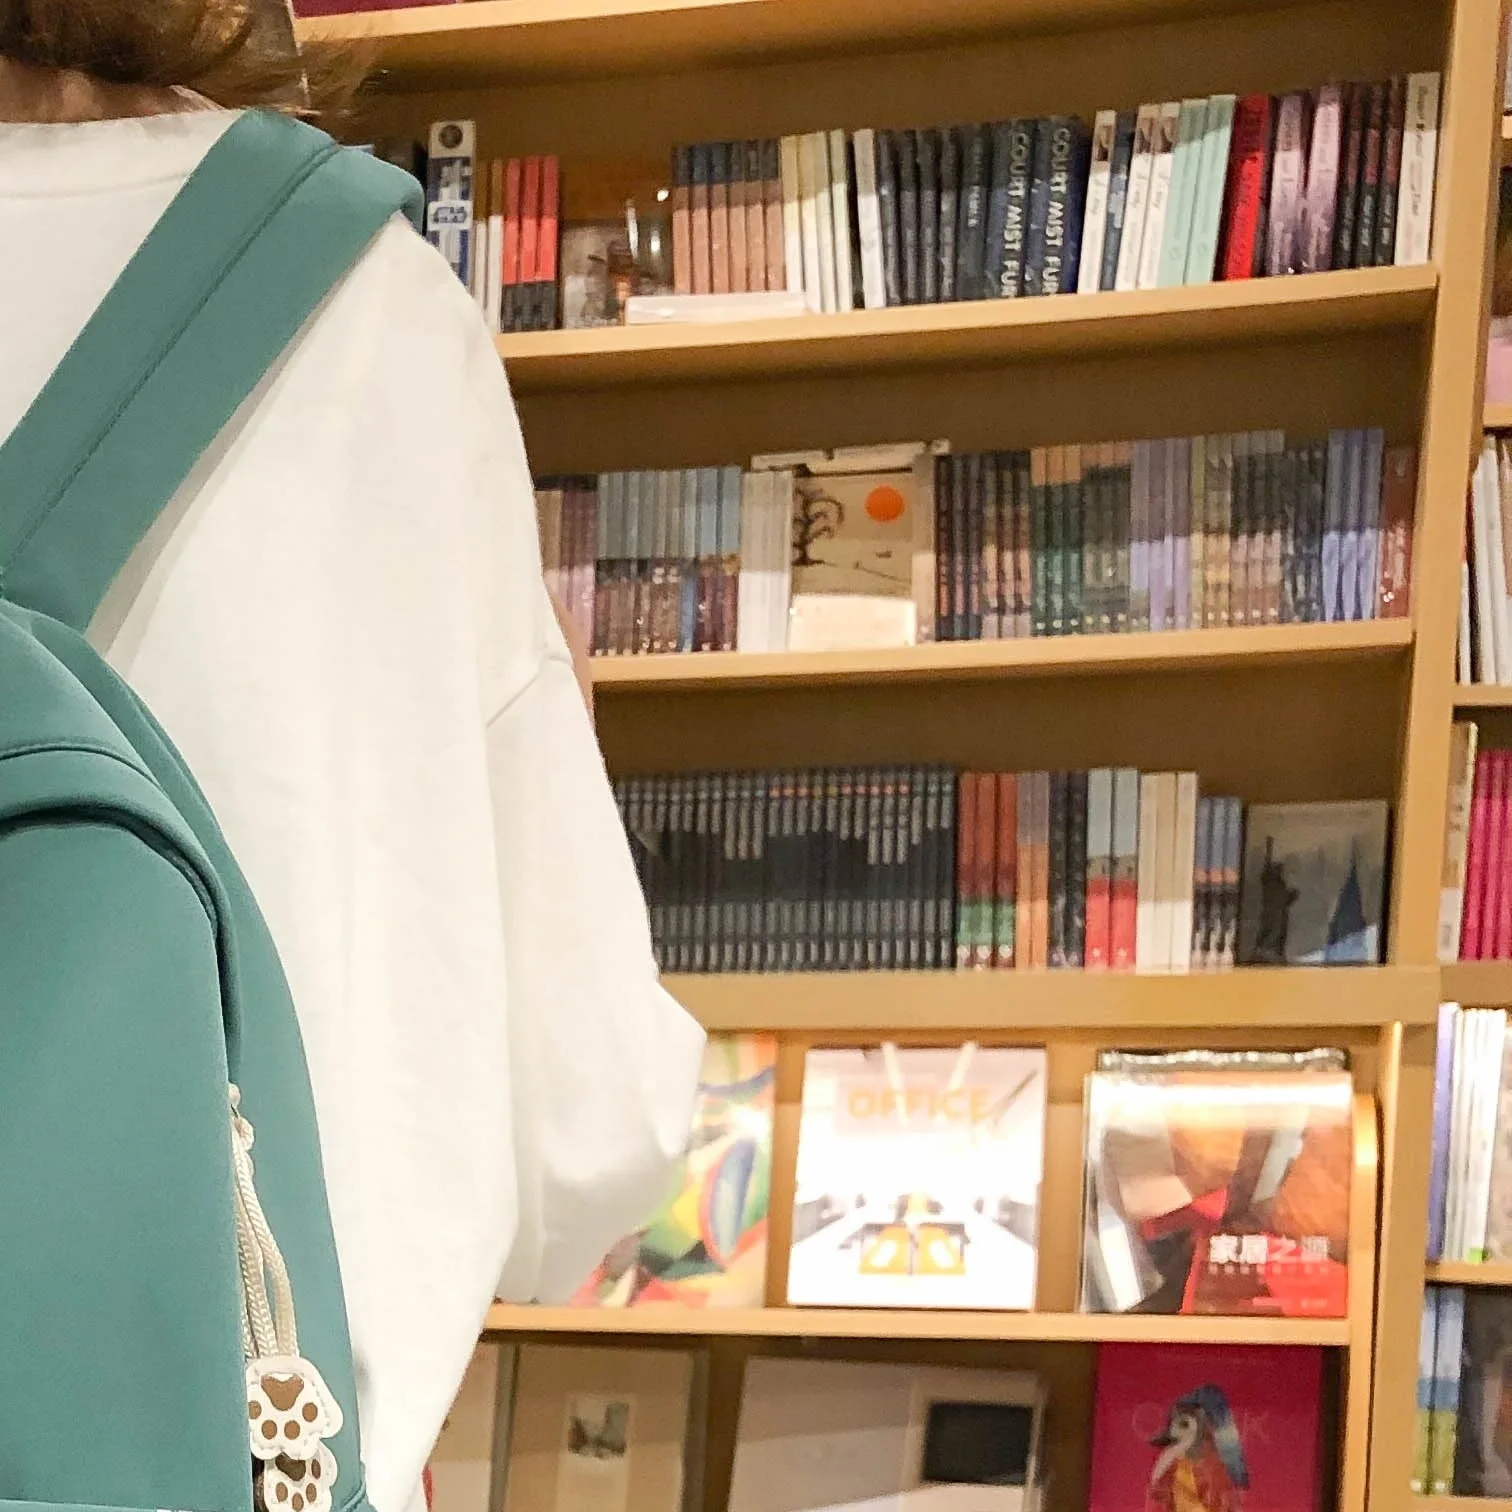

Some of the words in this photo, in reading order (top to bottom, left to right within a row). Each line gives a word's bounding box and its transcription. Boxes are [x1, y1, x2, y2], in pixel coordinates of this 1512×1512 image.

[1008, 132, 1030, 198] COURT
[1049, 127, 1071, 195] COURT
[1004, 204, 1023, 251] MIST
[1045, 200, 1064, 247] MIST
[1001, 260, 1019, 297] FUR
[1042, 255, 1062, 295] FUR
[846, 1087, 990, 1124] OFFICE
